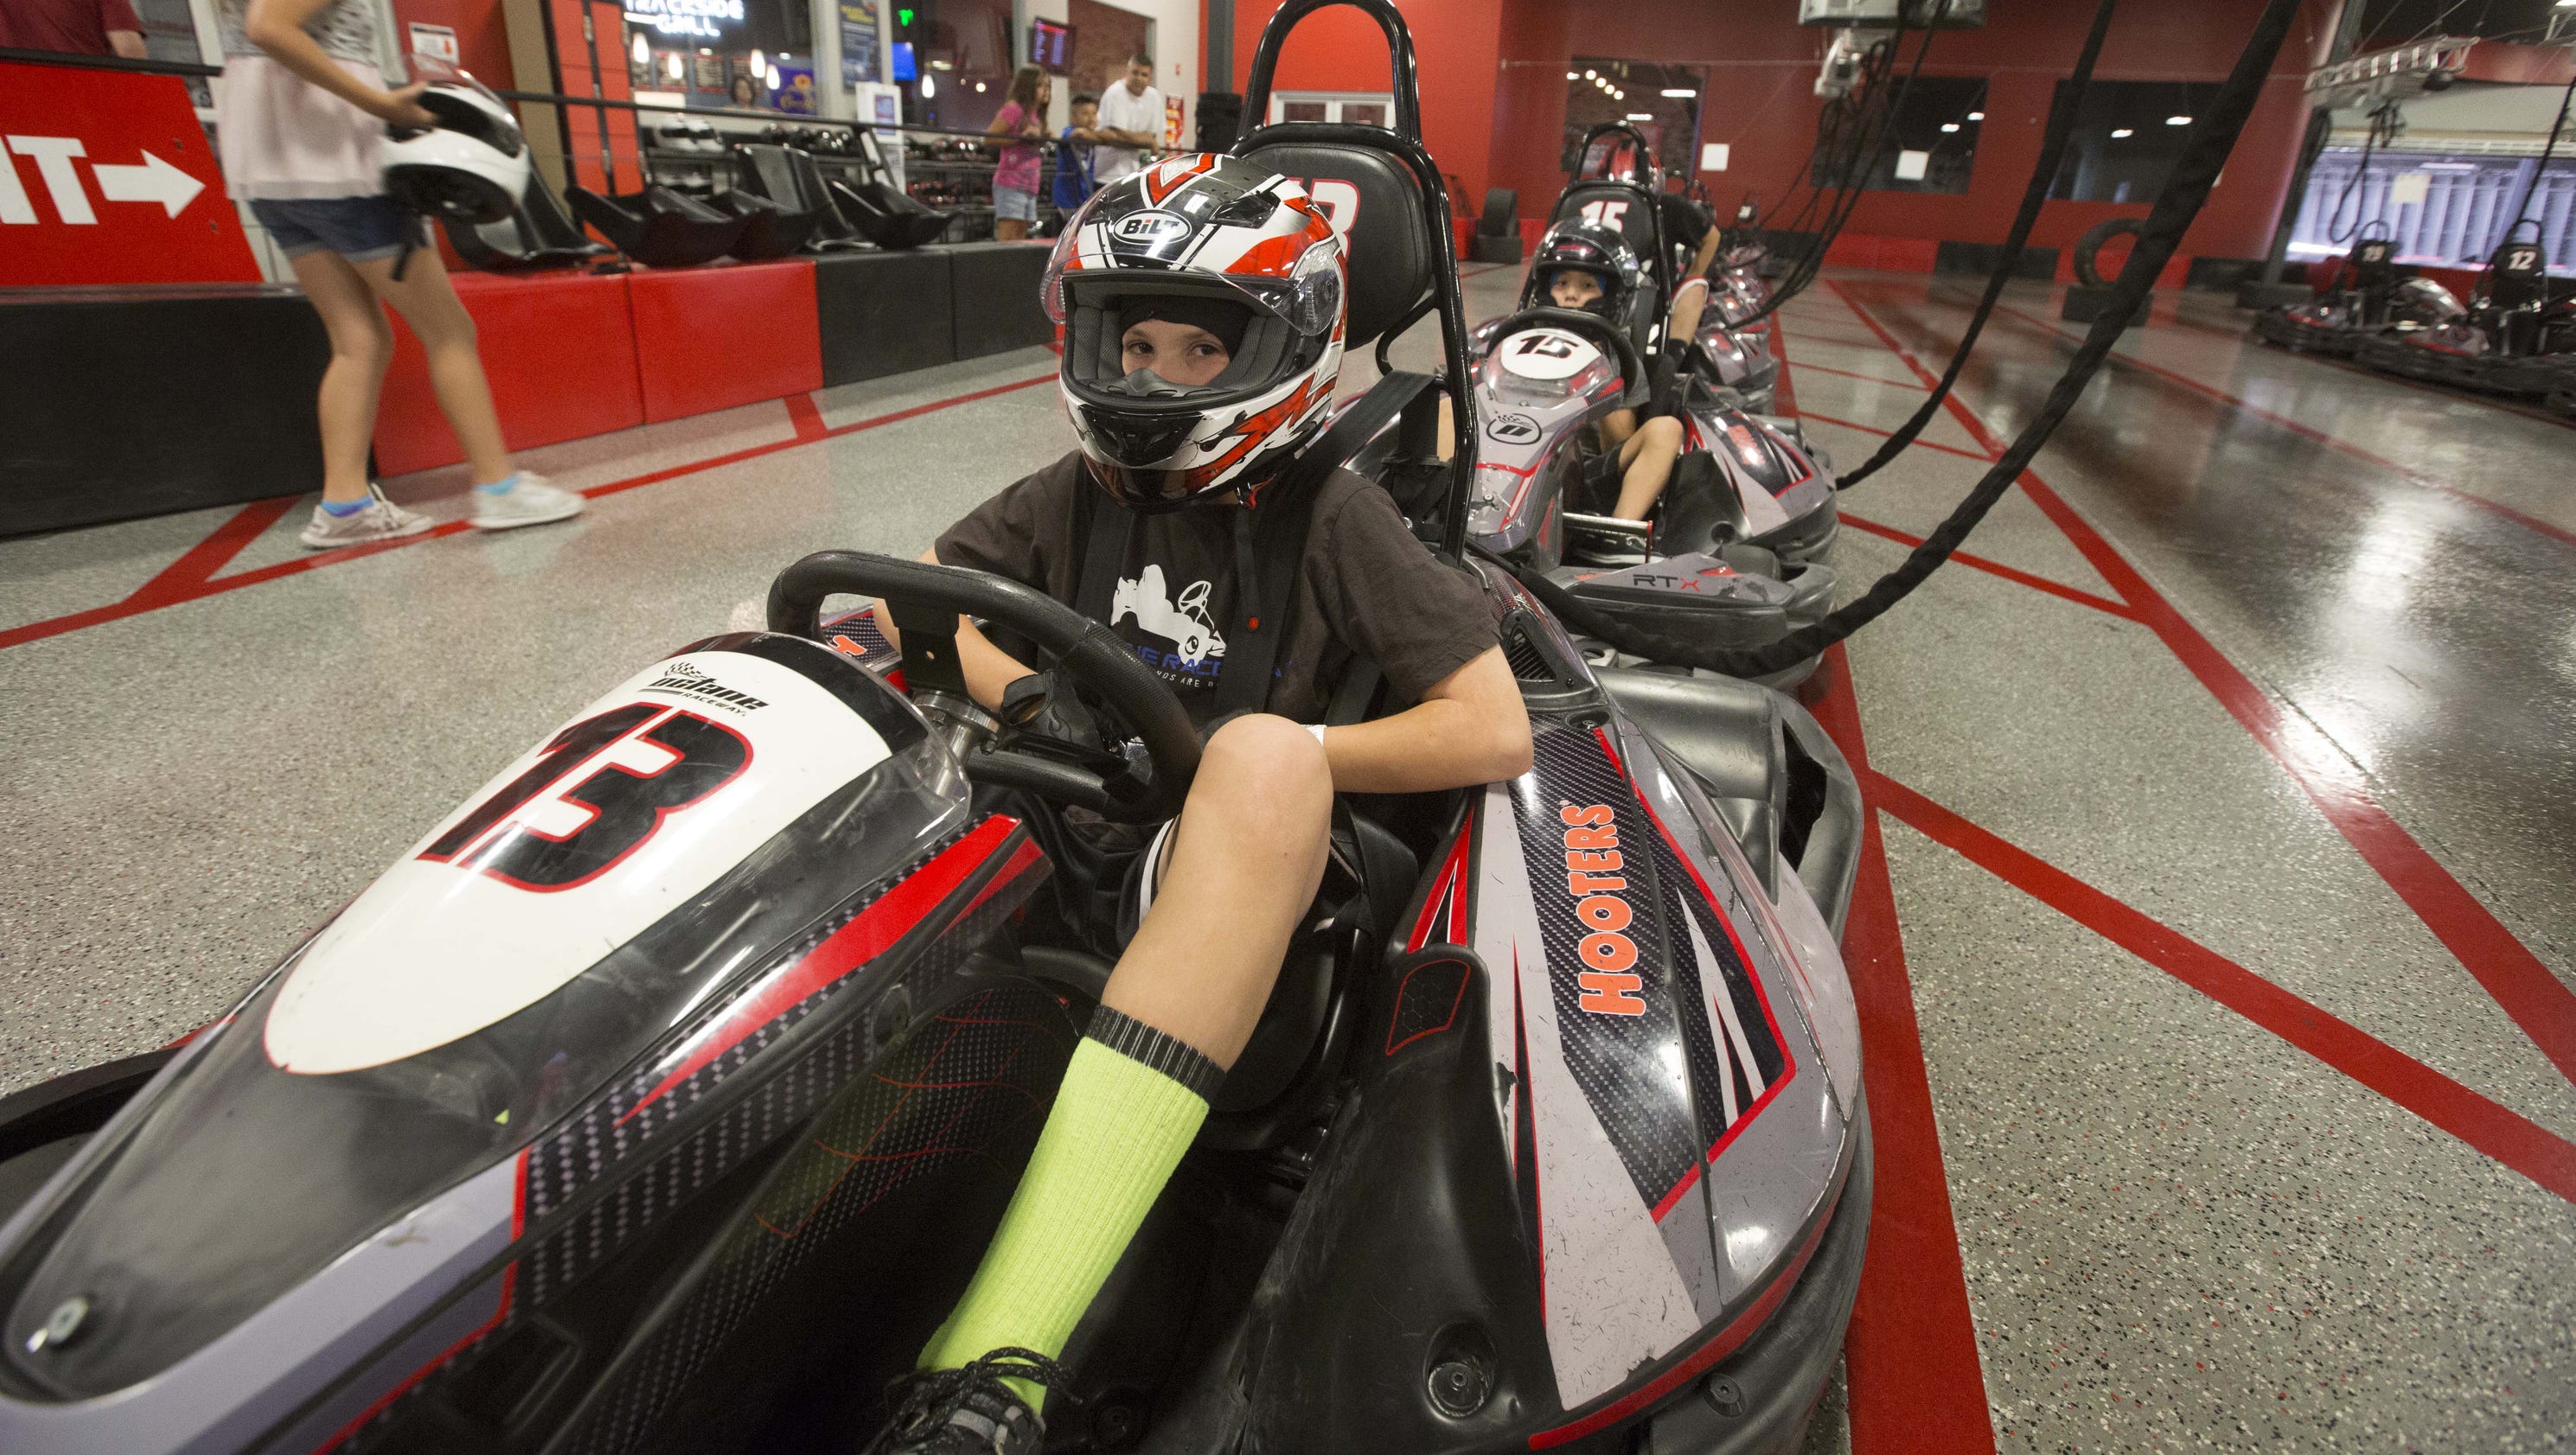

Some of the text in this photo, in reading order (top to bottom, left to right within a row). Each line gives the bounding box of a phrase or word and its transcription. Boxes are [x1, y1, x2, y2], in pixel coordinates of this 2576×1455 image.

[655, 14, 721, 37] GRILL
[2509, 250, 2536, 270] 12
[1516, 335, 1580, 360] 15
[1633, 573, 1701, 592] RTX
[1179, 676, 1201, 688] ARE
[682, 692, 746, 716] RACEWAY
[413, 700, 754, 894] 13
[1559, 803, 1647, 1017] HOOTERS
